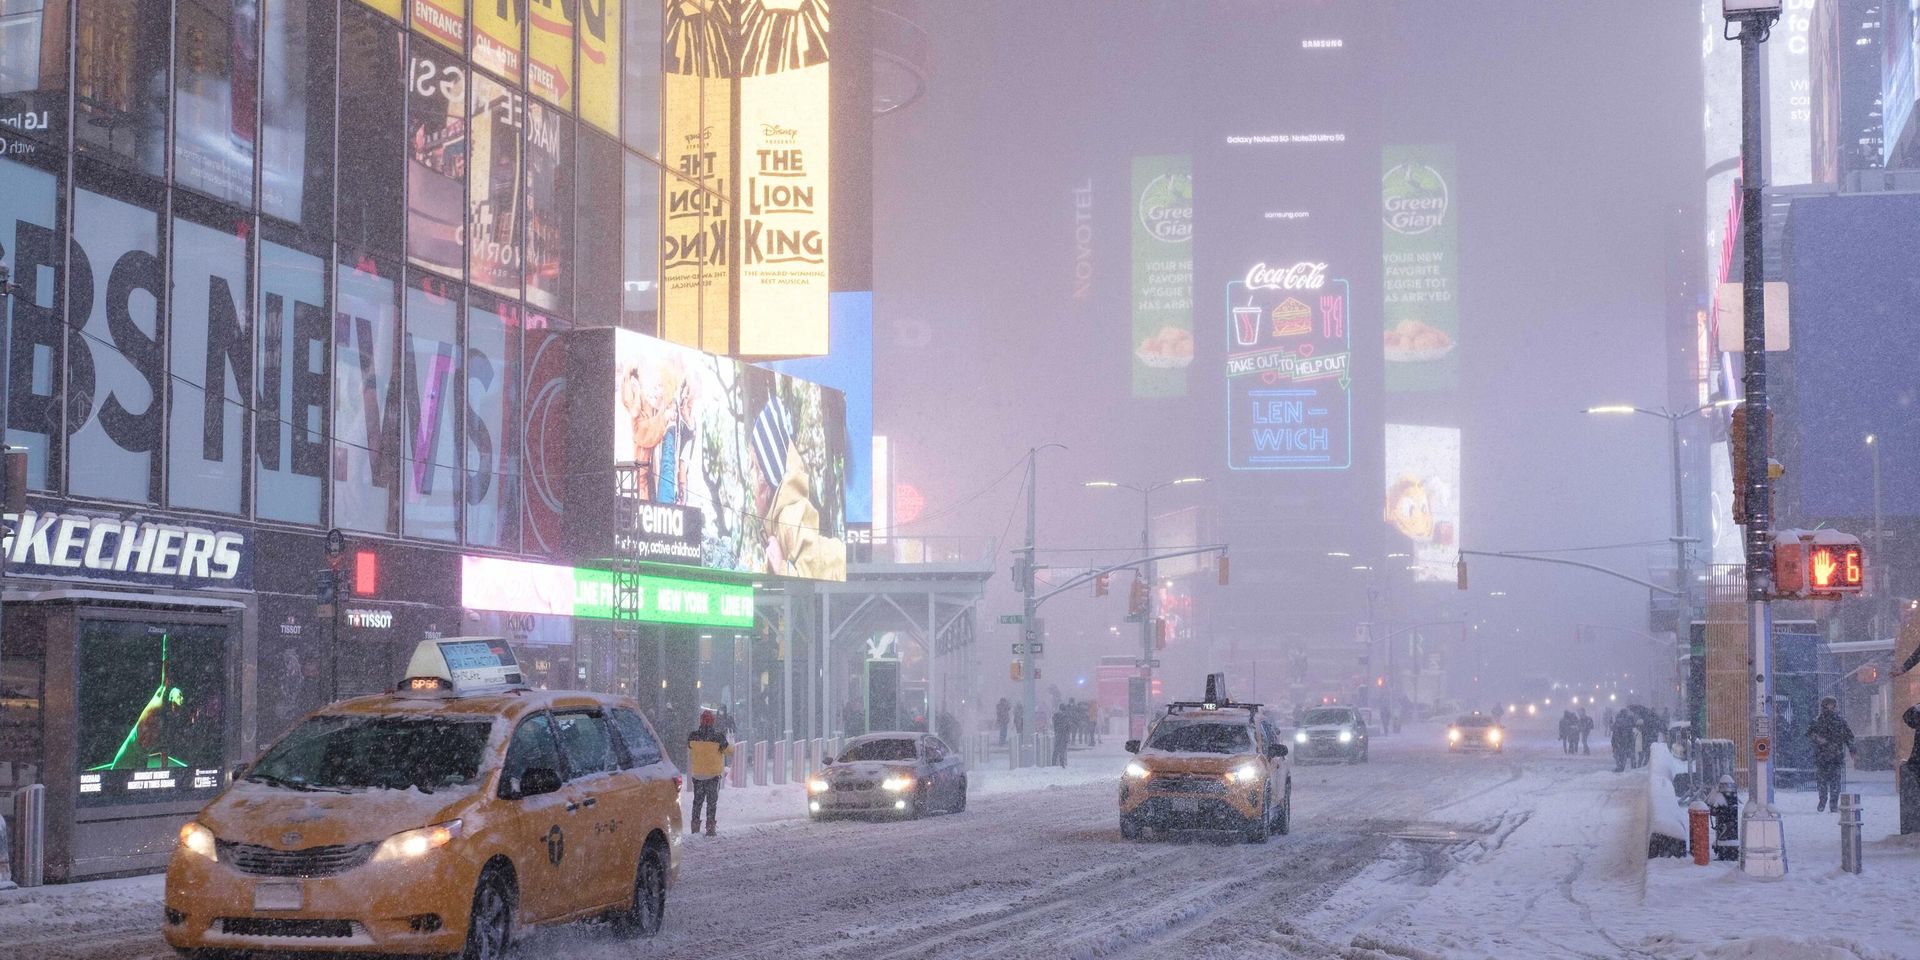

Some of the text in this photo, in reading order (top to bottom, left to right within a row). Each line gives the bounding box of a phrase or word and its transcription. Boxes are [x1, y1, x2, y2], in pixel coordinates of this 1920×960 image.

[415, 0, 463, 40] ENTRANCE
[476, 34, 491, 55] ON
[1302, 40, 1343, 48] SAMSUNG
[529, 63, 554, 90] STREET
[760, 123, 798, 138] Disney
[1227, 136, 1252, 144] Galaxy
[757, 149, 803, 171] THE
[749, 177, 814, 216] LION
[1385, 196, 1442, 212] Green
[1265, 210, 1310, 218] samsung.com
[1392, 211, 1442, 228] Giant
[744, 219, 823, 265] KING
[1073, 177, 1092, 298] NOVOTEL
[1383, 251, 1444, 264] YOUR NEW
[1386, 265, 1440, 277] FAVORITE
[1424, 278, 1448, 289] TOT
[1402, 291, 1452, 303] ARRIVED
[1228, 354, 1280, 374] TAKE OUT
[1279, 355, 1346, 376] TO HELP OUT
[203, 274, 495, 506] NEWS
[1251, 428, 1328, 451] WICH
[650, 540, 671, 555] active
[671, 541, 701, 558] childhood
[1846, 553, 1860, 583] 6
[280, 625, 301, 635] TISSOT
[360, 614, 393, 628] TISSOT
[504, 614, 536, 633] KIKO
